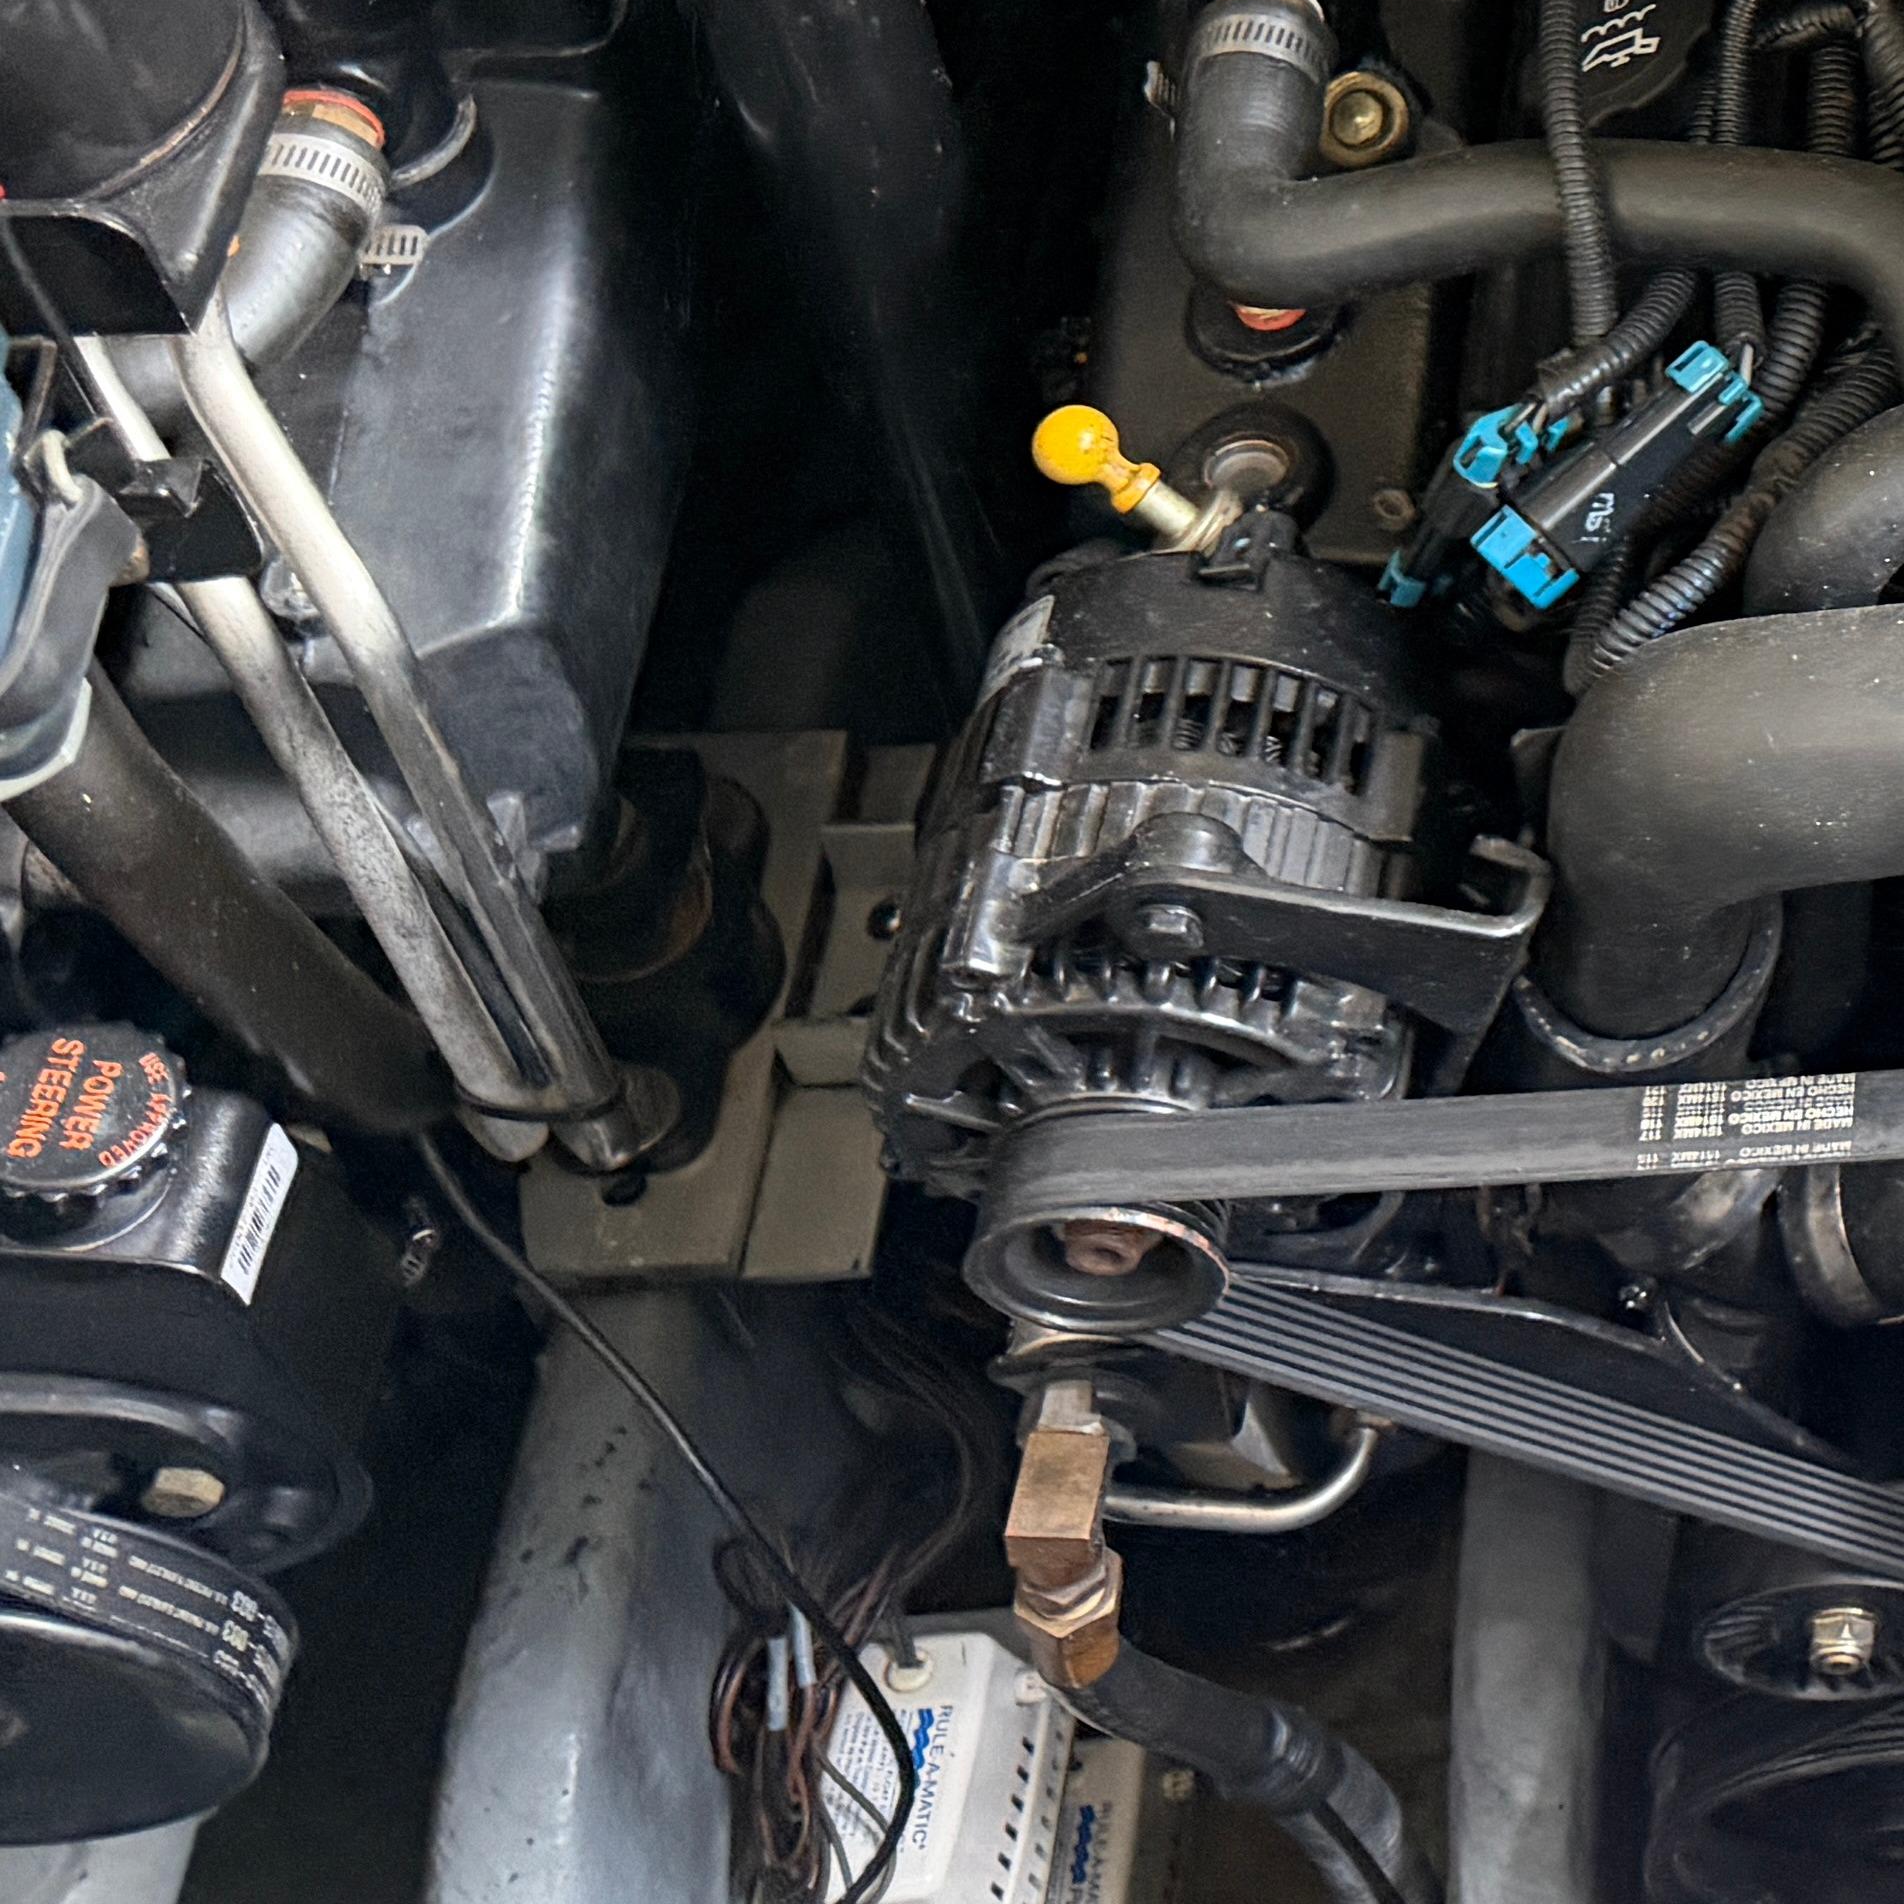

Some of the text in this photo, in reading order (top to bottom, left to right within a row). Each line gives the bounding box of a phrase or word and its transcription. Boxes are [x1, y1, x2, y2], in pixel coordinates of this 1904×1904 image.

[4, 1040, 87, 1160] STEERING
[58, 1059, 123, 1154] POWER
[97, 1091, 172, 1168] APPROVED
